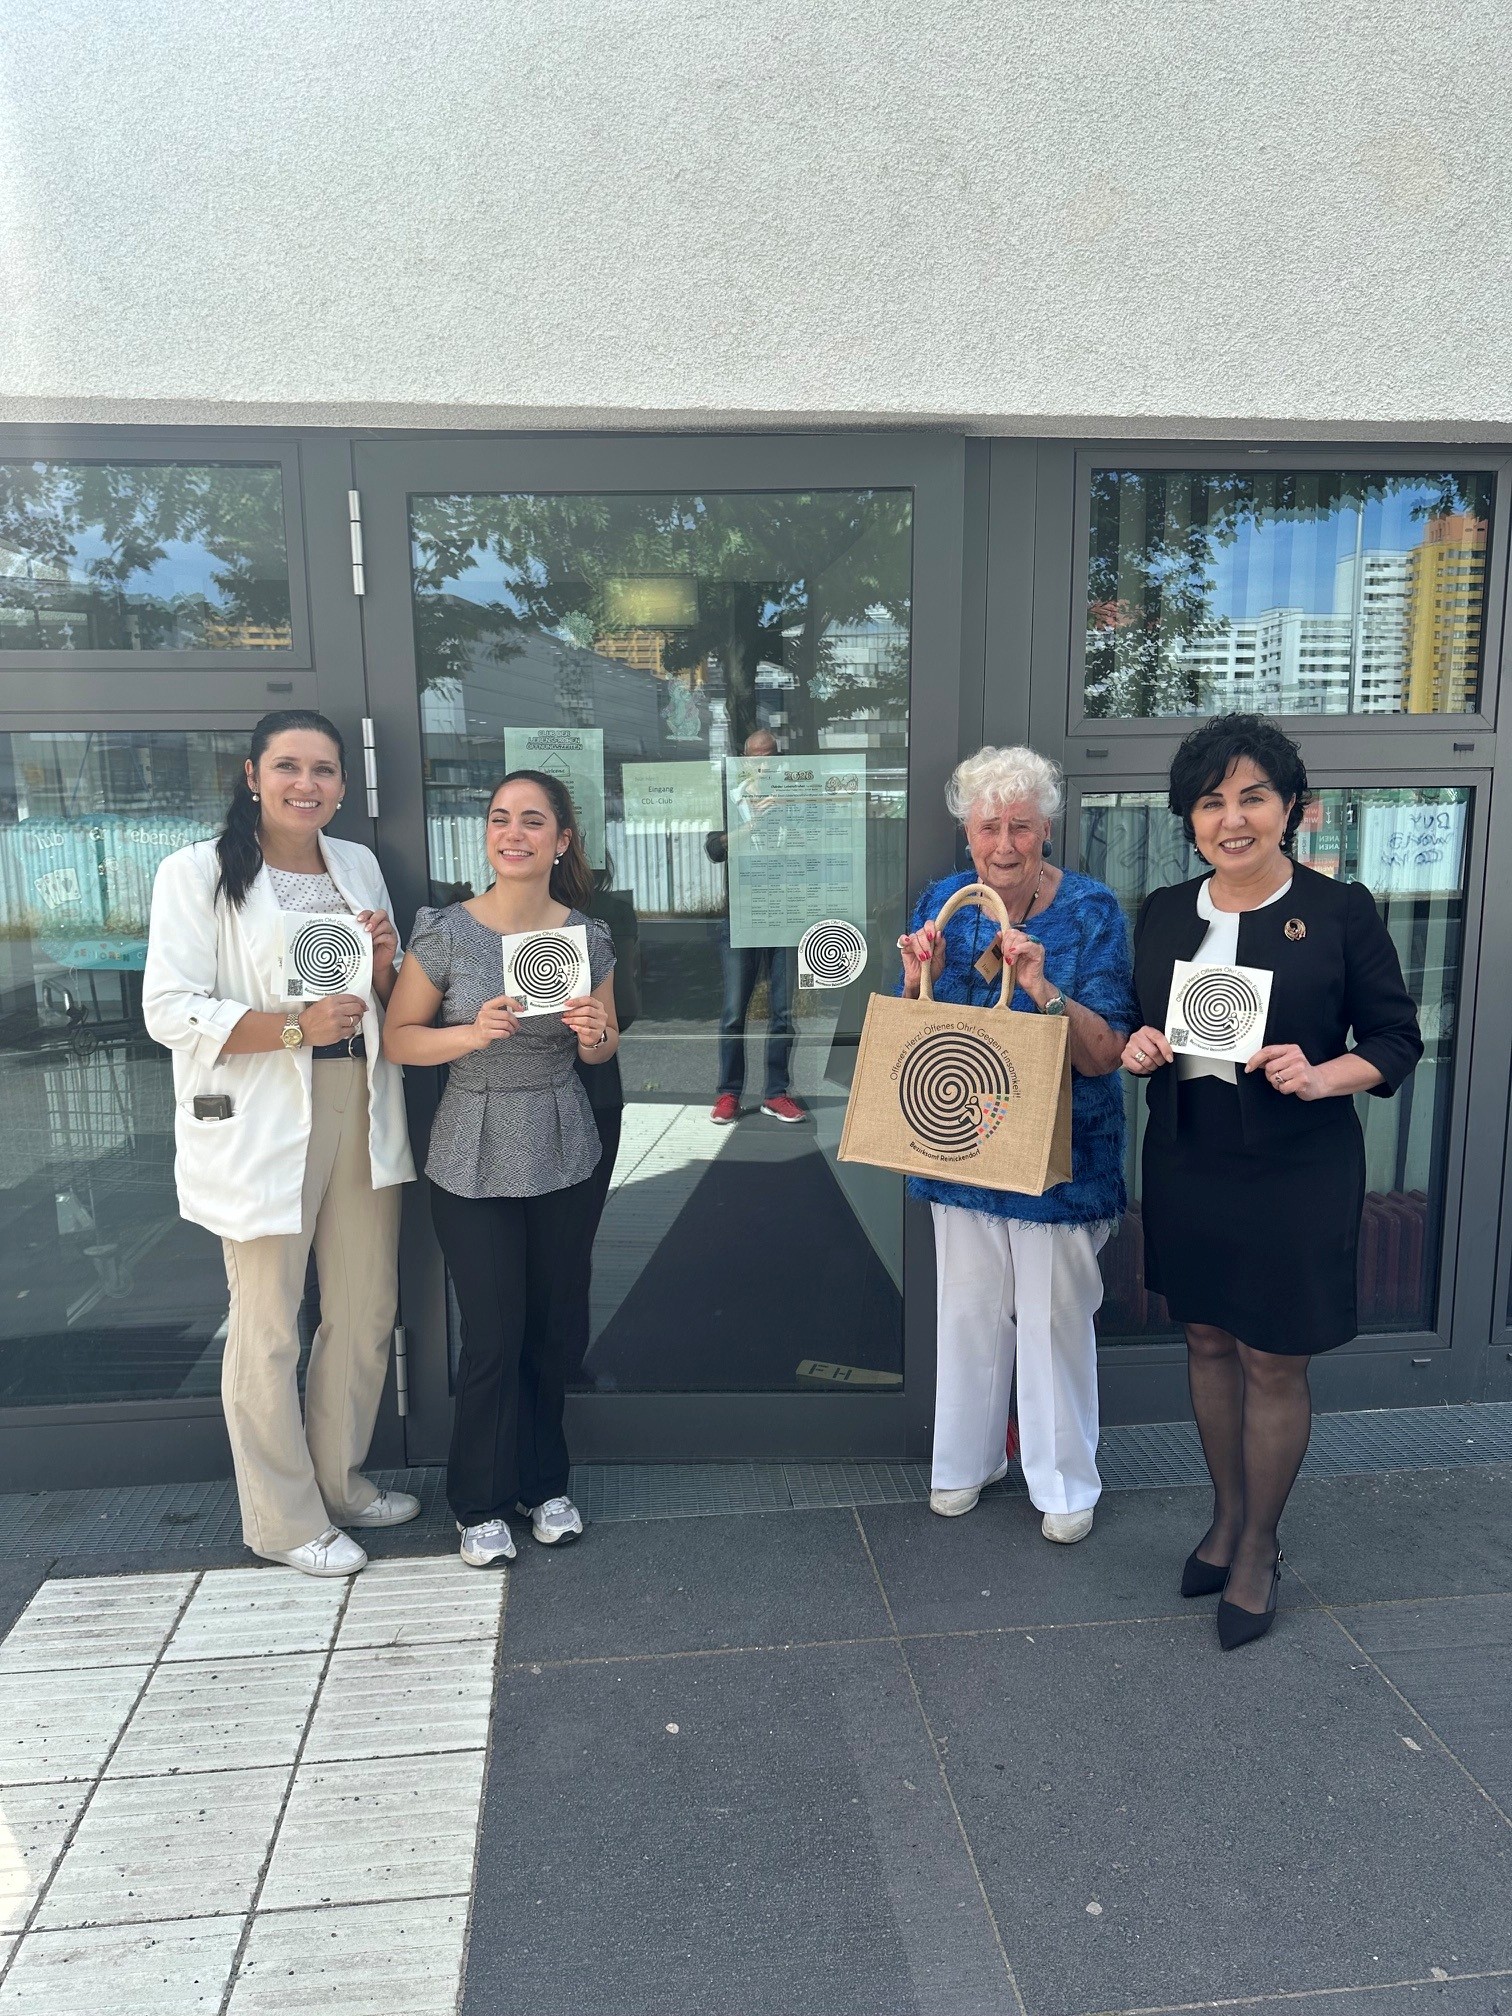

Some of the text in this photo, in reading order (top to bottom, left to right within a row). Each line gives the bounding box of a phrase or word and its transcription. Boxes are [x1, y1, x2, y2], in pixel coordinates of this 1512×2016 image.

[74, 948, 130, 962] SEIOREN
[889, 1021, 1021, 1099] Offenes Herz! Offenes Ohr! Gegen Einsamkeit!
[909, 1141, 981, 1162] Bezirksamt Reinickendorf
